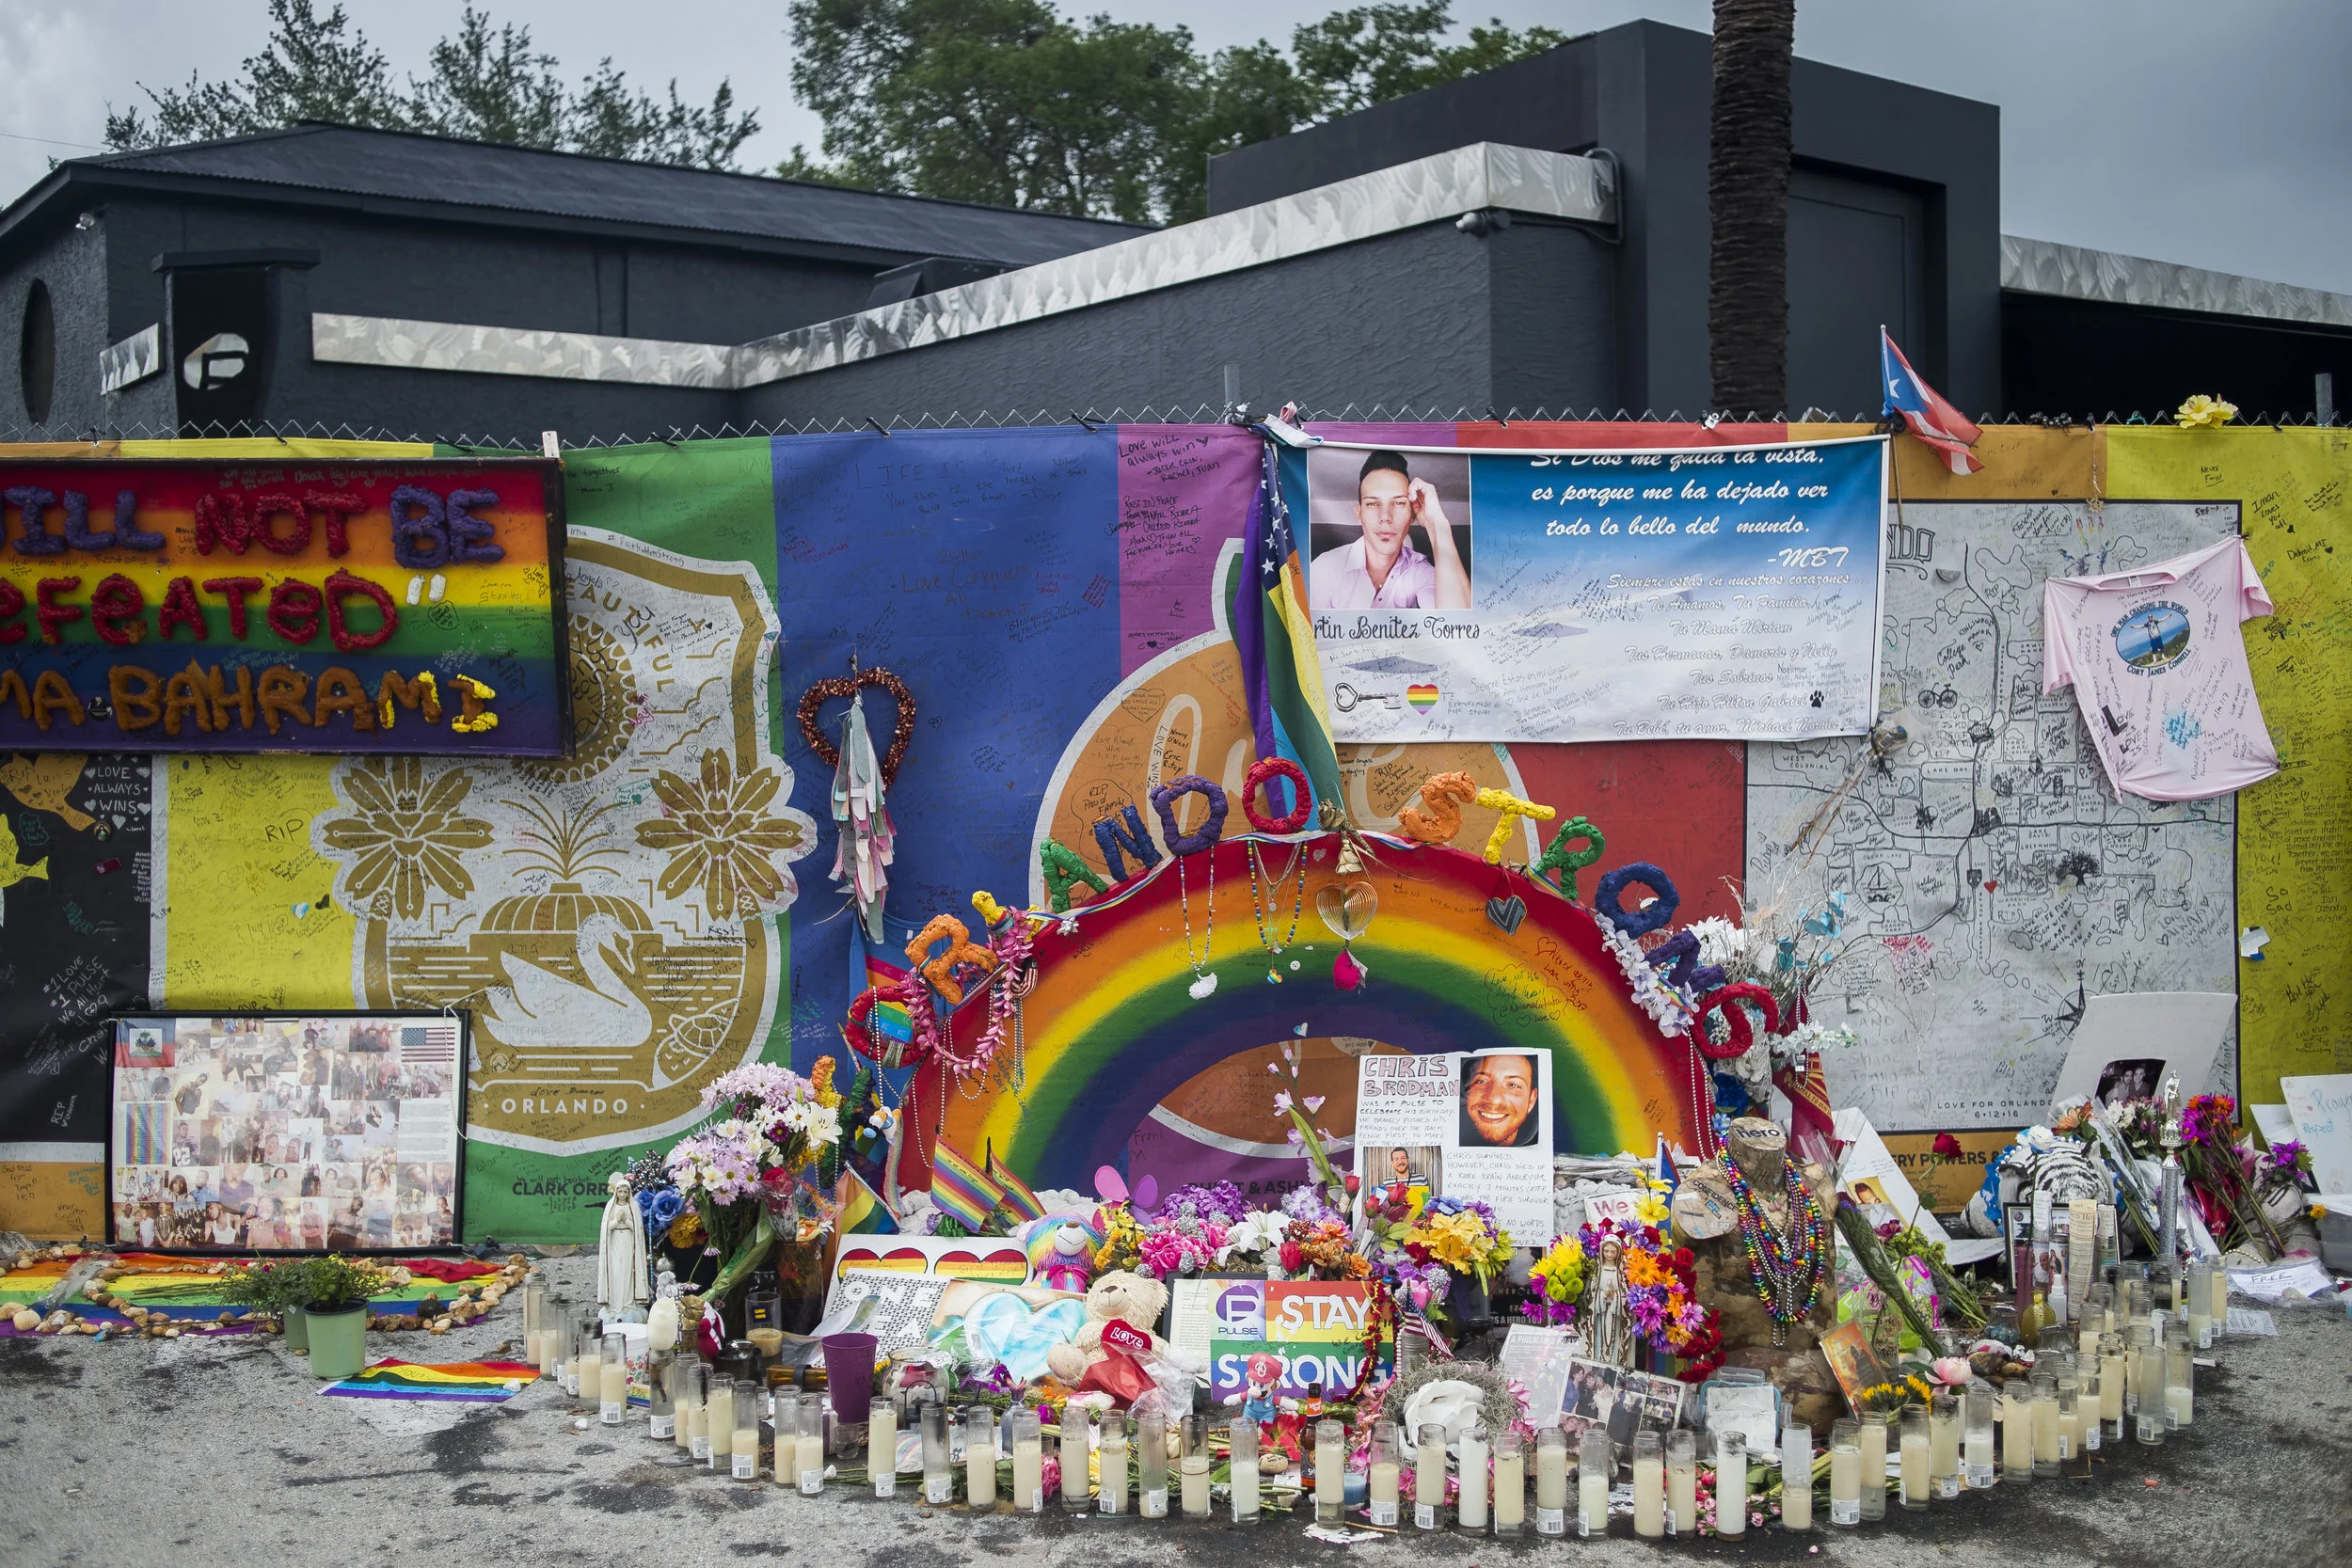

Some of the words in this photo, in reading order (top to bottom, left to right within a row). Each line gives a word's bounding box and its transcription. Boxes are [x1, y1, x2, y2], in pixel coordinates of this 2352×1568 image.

[1119, 440, 1148, 458] Love
[1630, 454, 1661, 467] me
[1765, 449, 1823, 464] vista.
[1532, 486, 1553, 500] es
[1560, 485, 1635, 506] porque
[1642, 485, 1673, 499] me
[1680, 480, 1708, 499] ha
[1716, 480, 1789, 505] dejado
[1797, 483, 1828, 498] ver
[0, 485, 166, 555] ILL
[196, 490, 366, 558] NOT
[389, 484, 505, 570] BE
[1546, 517, 1591, 536] todo
[1599, 517, 1619, 536] lo
[1628, 515, 1677, 535] bello
[1685, 515, 1720, 534] del
[1736, 515, 1810, 534] mundo.
[1606, 574, 1664, 590] Siempre
[1708, 576, 1724, 586] en
[1728, 575, 1784, 586] nuestros
[1788, 573, 1850, 590] corazones
[1646, 595, 1665, 611] Te
[1665, 596, 1725, 611] Amamos,
[1733, 594, 1753, 610] Tu
[2129, 602, 2156, 619] CHANGING
[2157, 600, 2170, 609] THE
[2170, 602, 2189, 616] WORLD
[566, 579, 675, 694] EAUTIFUL
[1313, 617, 1343, 640] rtin
[1349, 615, 1421, 640] Benitez
[1669, 621, 1688, 637] Tu
[1740, 619, 1792, 634] Miriam
[1958, 617, 1994, 638] KINGSWOOD
[1625, 645, 1649, 662] Tus
[1729, 643, 1786, 659] Damaris
[1790, 647, 1799, 662] y
[1801, 641, 1837, 662] Nelly
[2126, 666, 2144, 676] CORY
[2148, 667, 2167, 678] JAMES
[2168, 647, 2192, 669] CONNELL
[1690, 670, 1714, 686] Tus
[1718, 669, 1773, 684] Sobrinos
[109, 662, 498, 735] BAHRAMI
[1657, 695, 1674, 712] Tu
[1759, 692, 1807, 709] Gabriel
[1614, 720, 1633, 736] Tu
[1677, 722, 1691, 735] tu
[1736, 719, 1793, 734] Michael
[1795, 717, 1838, 732] Morales
[1152, 725, 1168, 757] LOVE
[1163, 750, 1183, 763] Eric
[98, 767, 131, 779] LOVE
[1151, 761, 1162, 790] WINS
[1789, 763, 1830, 771] COLONIAL
[94, 784, 140, 796] ALWAYS
[1089, 783, 1109, 797] RIP
[99, 800, 137, 815] WINS
[264, 818, 304, 843] RIP
[2265, 885, 2289, 903] So
[2265, 900, 2293, 916] Sad
[57, 954, 85, 980] LOVE
[67, 955, 103, 997] PULSE
[86, 967, 112, 994] Hurt
[1364, 1056, 1449, 1078] CHRIS
[1363, 1079, 1460, 1098] BRODMAN
[501, 1098, 629, 1115] ORLANDO
[1937, 1101, 1965, 1110] LOVE
[1972, 1101, 1994, 1109] FOR
[2000, 1100, 2053, 1108] ORLANDO
[1920, 1151, 1988, 1167] POWERS
[512, 1182, 565, 1196] CLARK
[573, 1182, 609, 1196] ORR
[1248, 1181, 1263, 1195] &
[1692, 1179, 1738, 1212] CONFIDENCE
[1593, 1197, 1629, 1218] We
[2249, 1271, 2293, 1284] FREE
[844, 1281, 941, 1308] ONE
[1281, 1294, 1373, 1331] STAY
[1218, 1327, 1258, 1336] PULSE
[1218, 1354, 1388, 1392] SRONG
